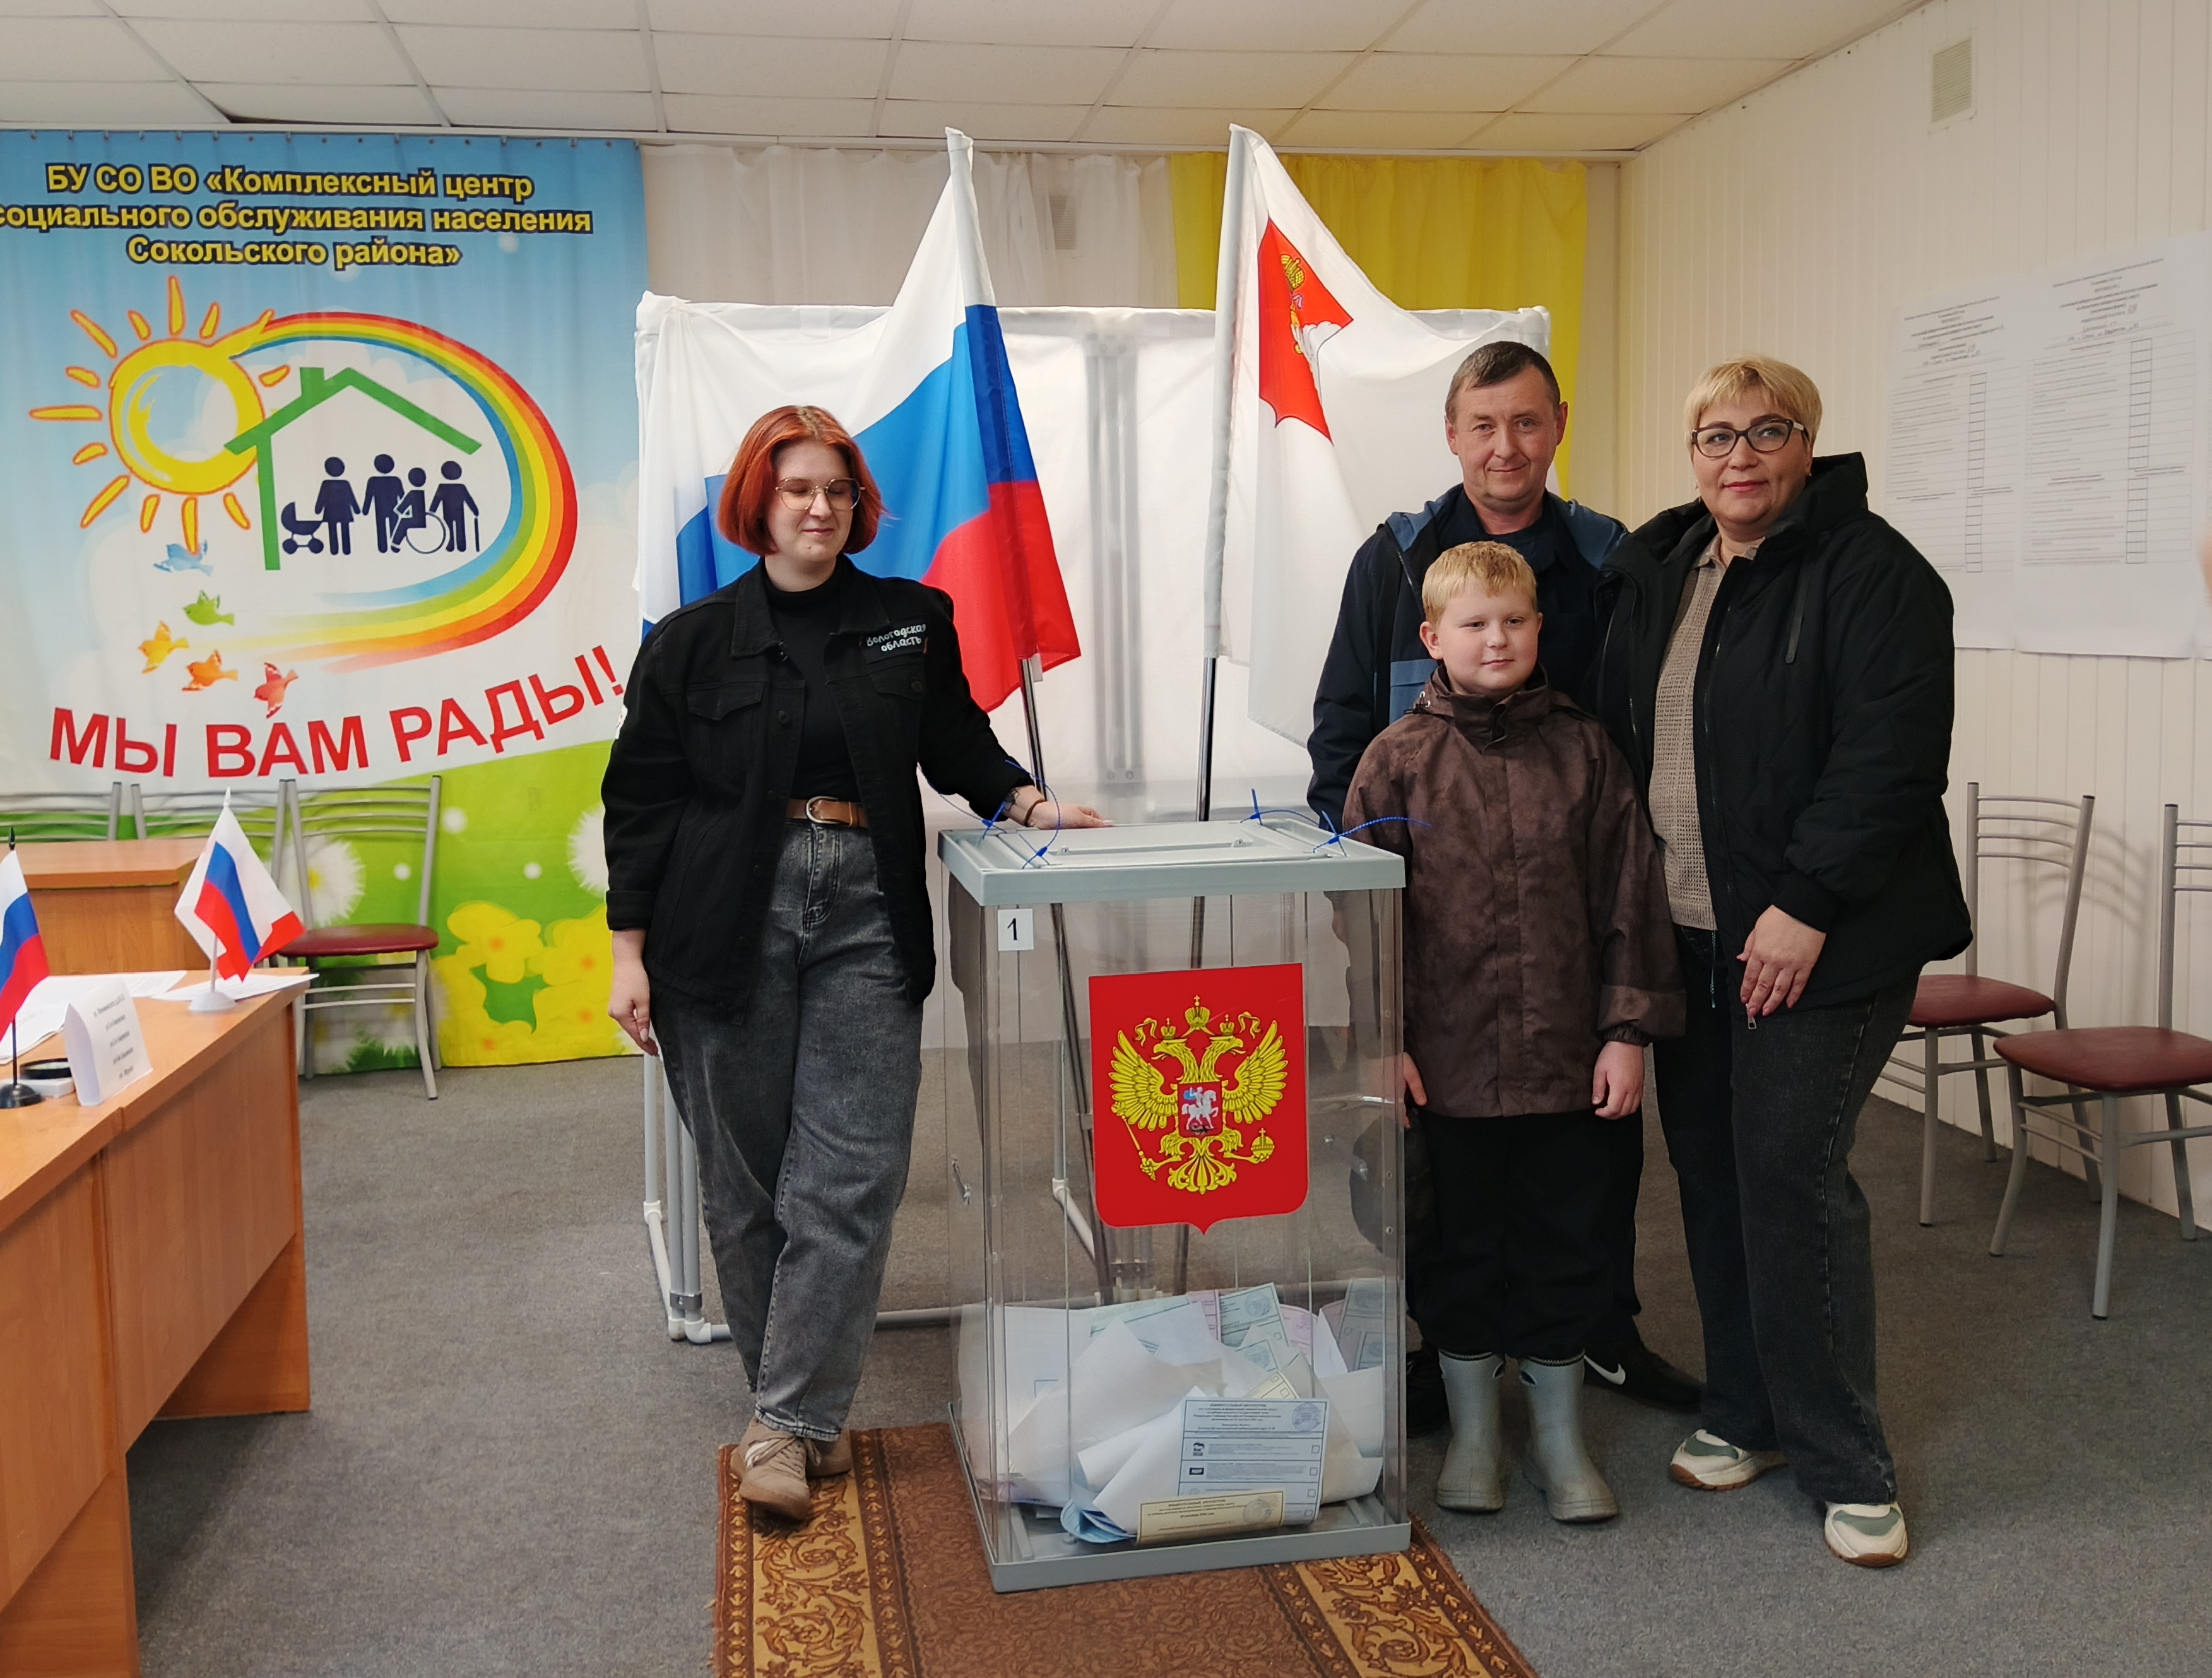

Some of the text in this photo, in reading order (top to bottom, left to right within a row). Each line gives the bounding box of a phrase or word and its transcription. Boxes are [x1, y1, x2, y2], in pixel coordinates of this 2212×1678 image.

[47, 165, 533, 201] БУ СО ВО «Комплексный центр
[0, 202, 591, 233] оциального обслуживания населения
[128, 237, 461, 269] Сокольского района»
[880, 636, 922, 652] область
[49, 644, 625, 777] МЫ ВАМ РАДЫ!
[1007, 918, 1018, 941] 1
